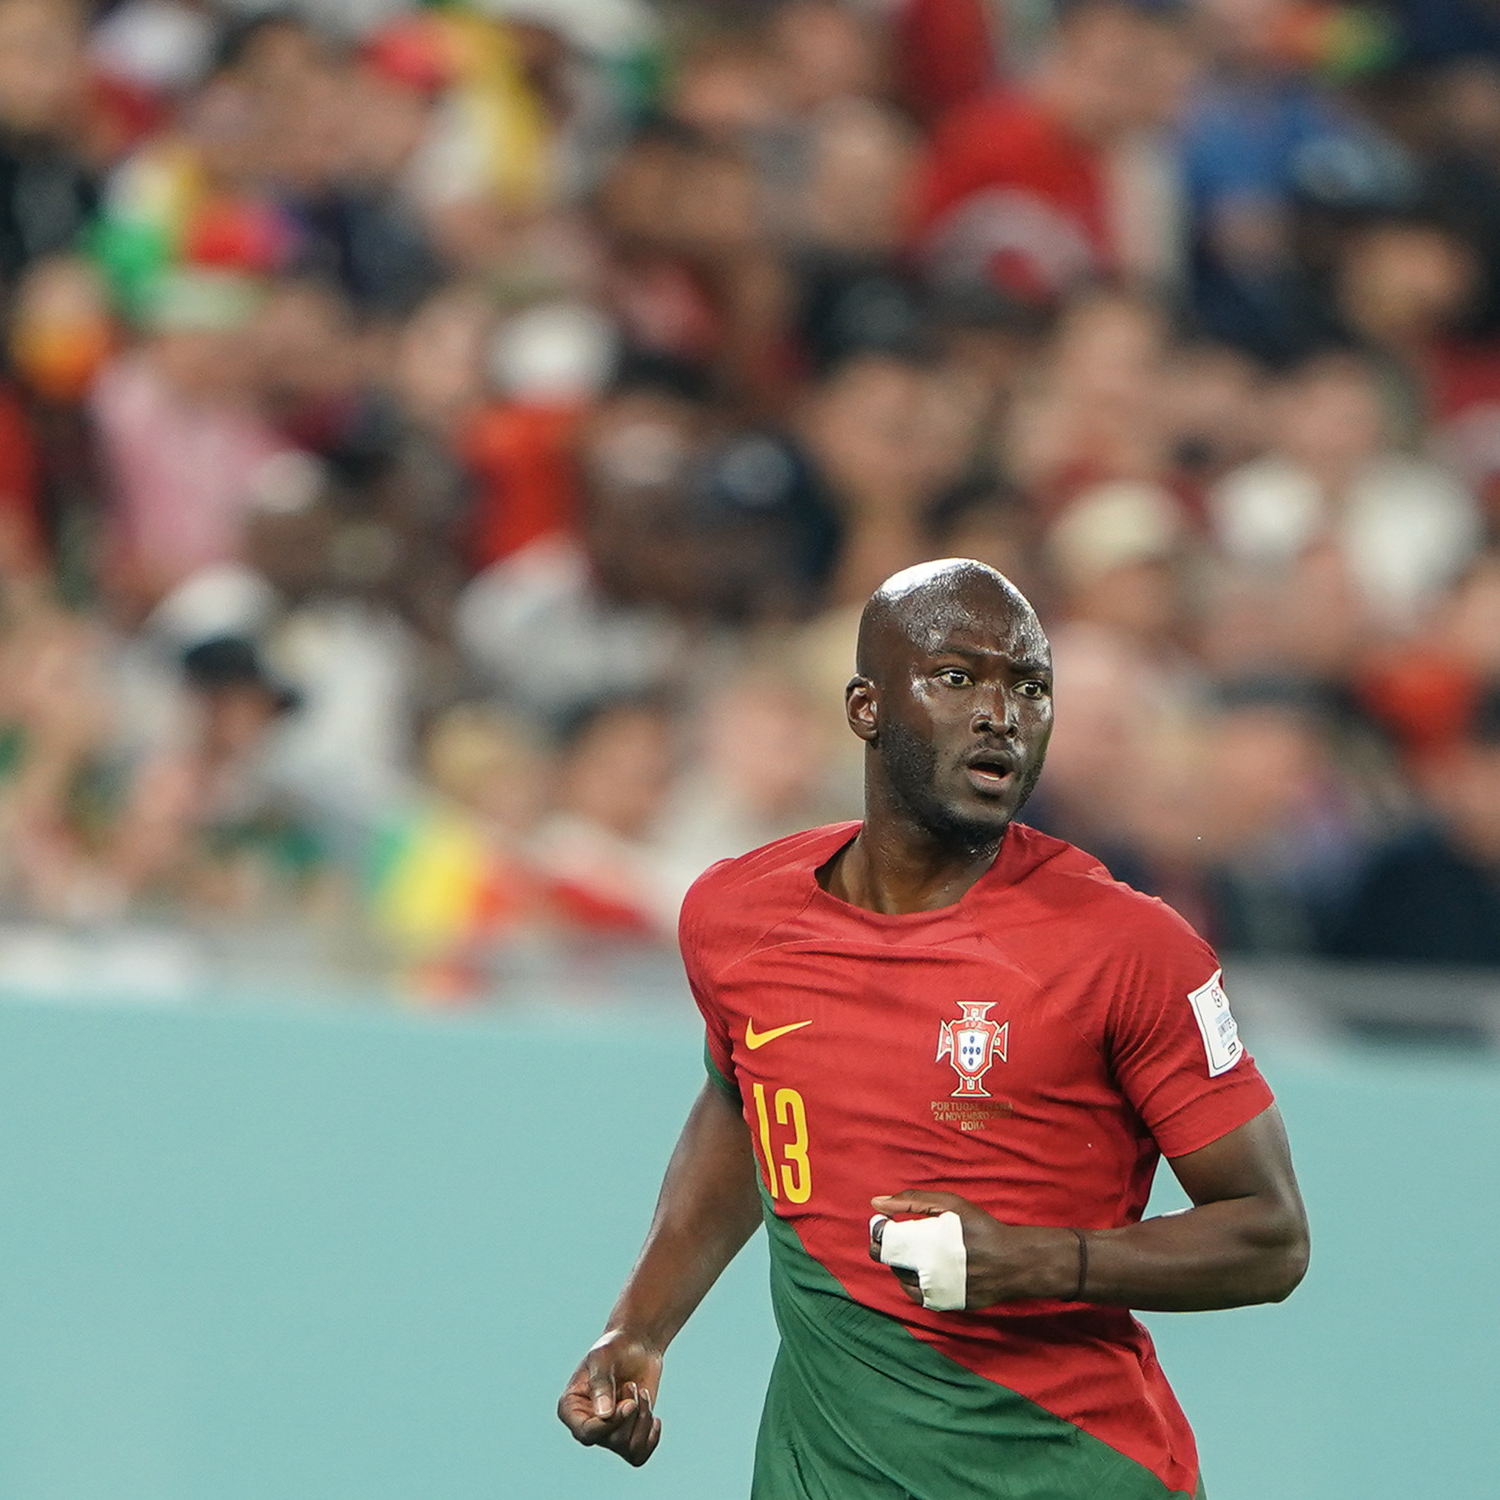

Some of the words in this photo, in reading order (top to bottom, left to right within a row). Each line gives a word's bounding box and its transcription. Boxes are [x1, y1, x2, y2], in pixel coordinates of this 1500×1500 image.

[930, 1101, 980, 1111] PORTUGAL
[933, 1111, 944, 1121] 24
[960, 1121, 985, 1131] DOHA
[753, 1083, 811, 1204] 13
